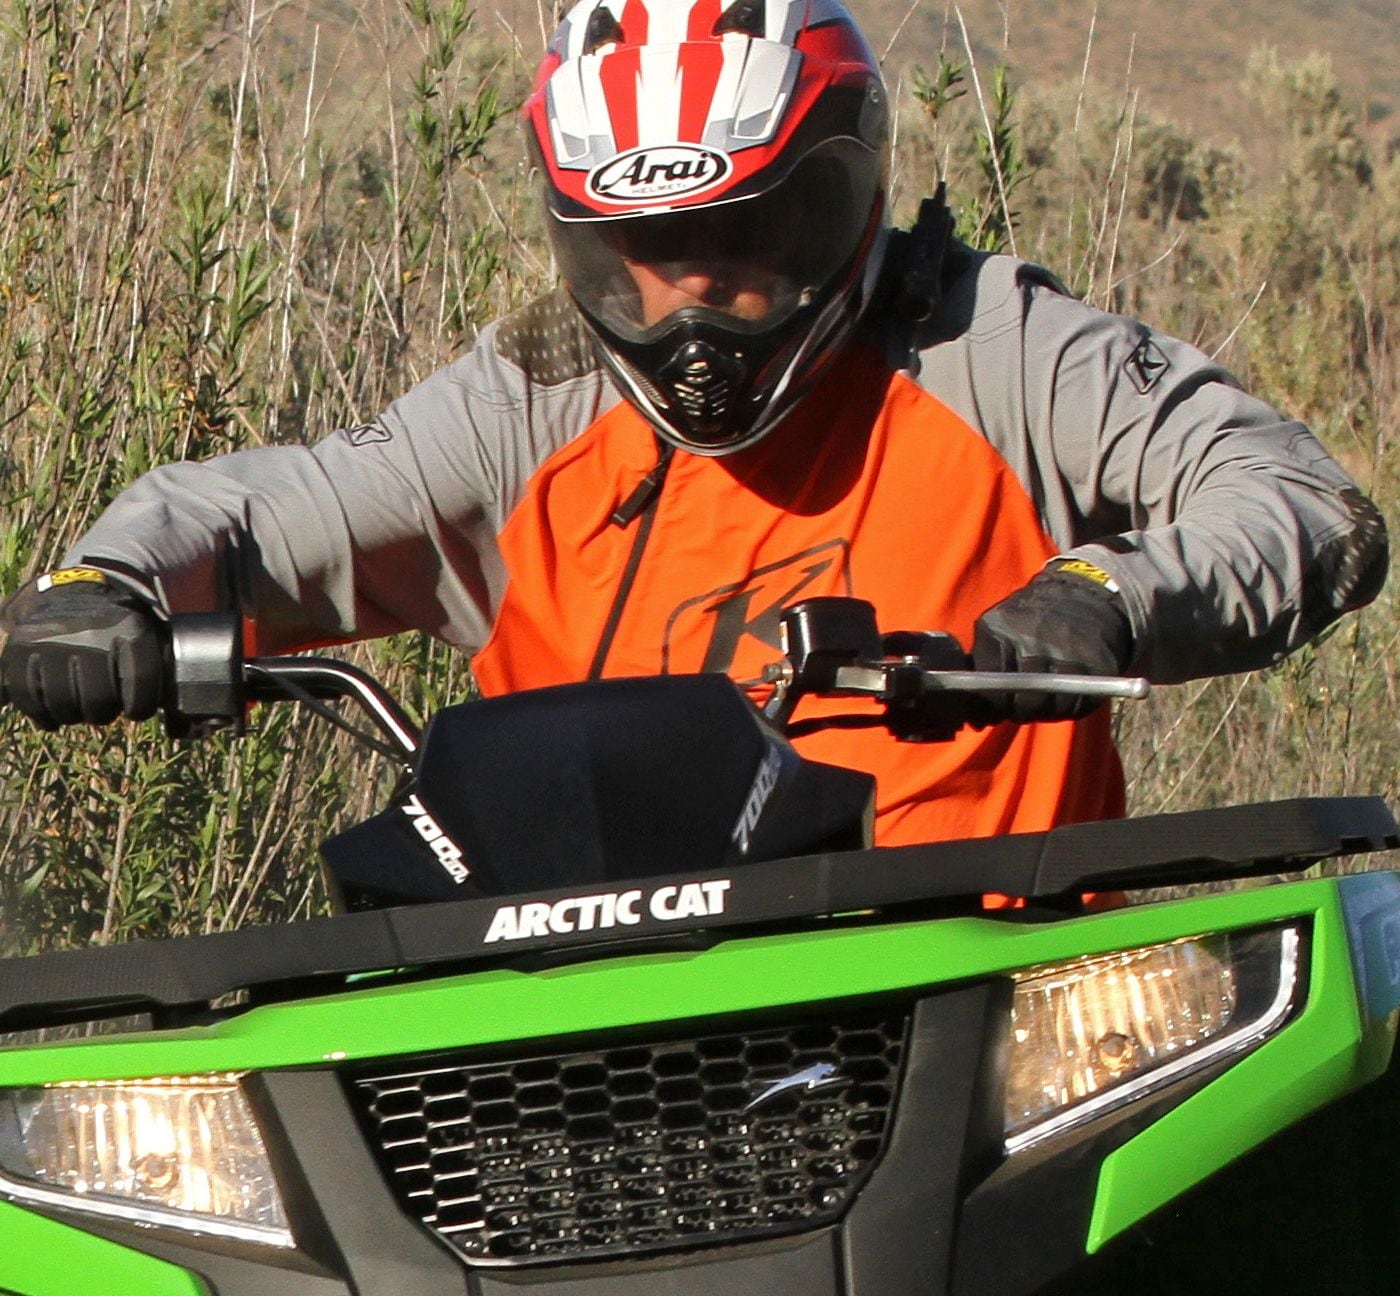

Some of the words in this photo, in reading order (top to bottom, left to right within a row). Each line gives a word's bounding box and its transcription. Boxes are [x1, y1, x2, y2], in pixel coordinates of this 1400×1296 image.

[600, 151, 710, 191] Arai
[483, 890, 642, 943] ARCTIC
[650, 880, 731, 921] CAT
